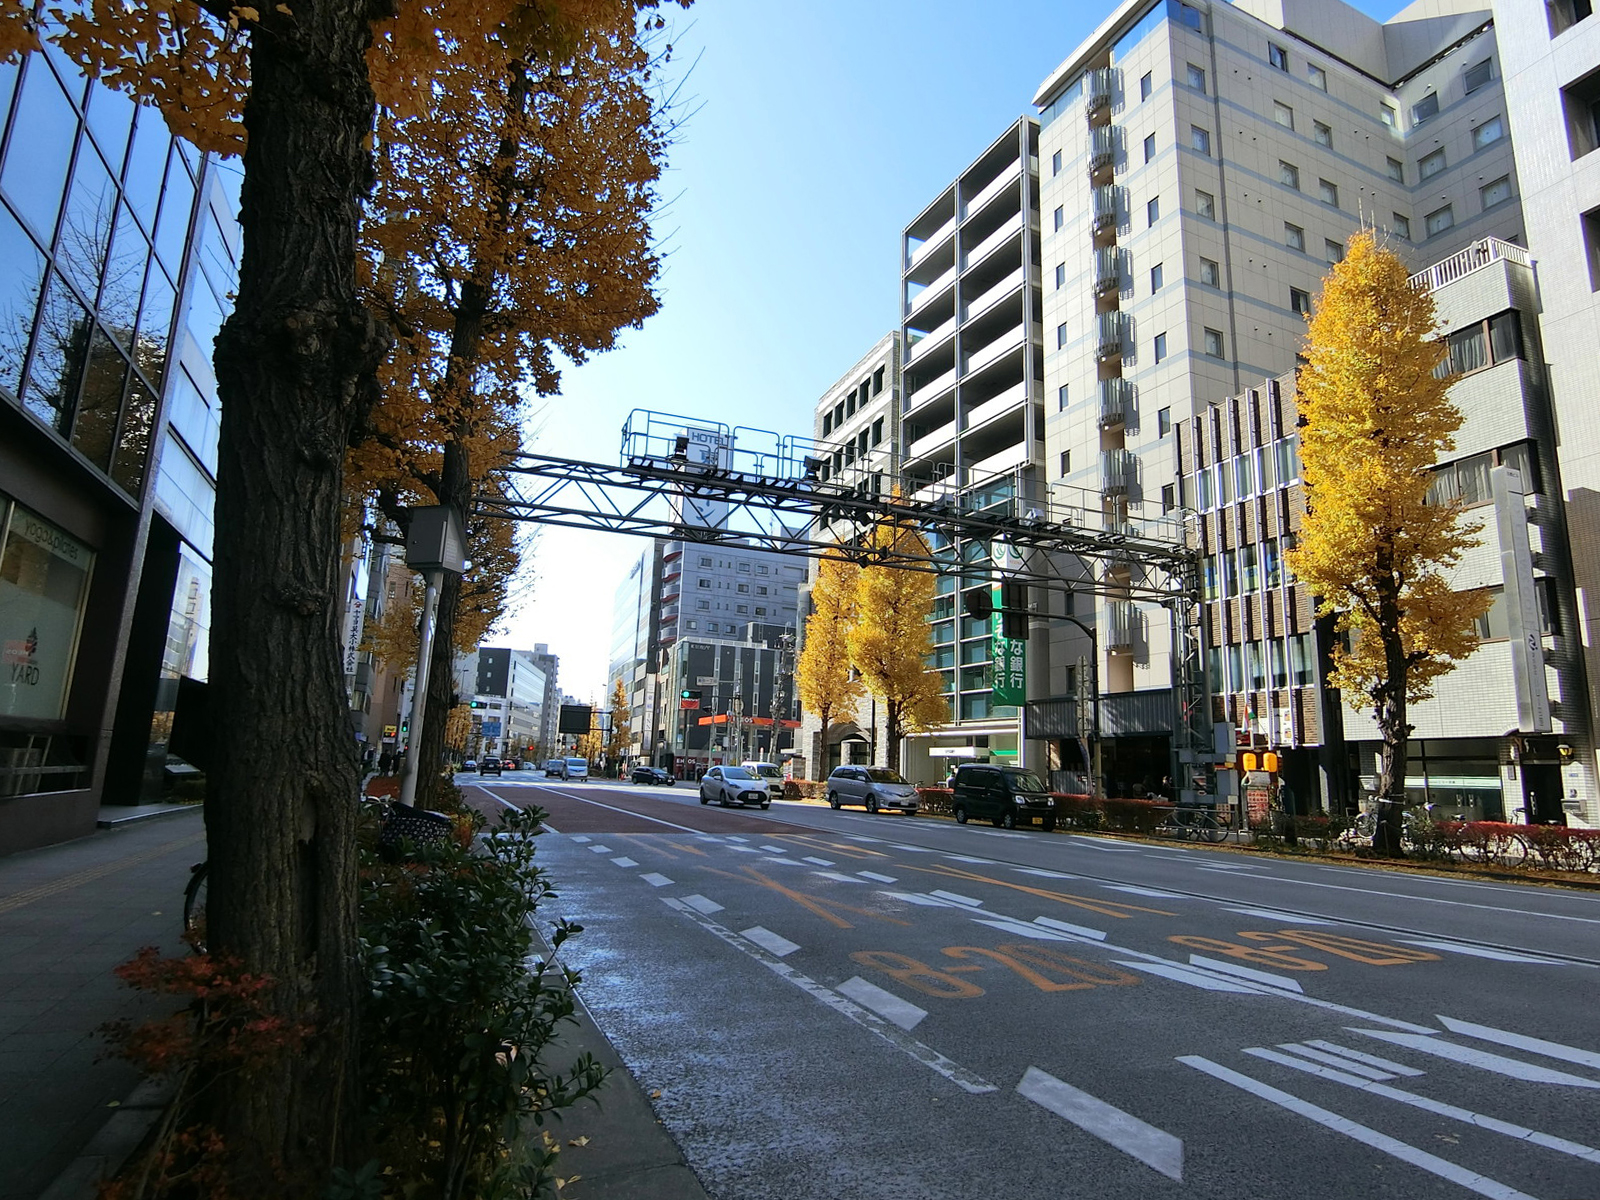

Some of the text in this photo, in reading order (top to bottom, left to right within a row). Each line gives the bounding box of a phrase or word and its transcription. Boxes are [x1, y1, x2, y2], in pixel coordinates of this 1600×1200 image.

[692, 431, 727, 446] HOTEL
[11, 662, 40, 686] YARD
[1010, 639, 1023, 689] な銀行
[849, 943, 1145, 999] 8-20
[1166, 929, 1444, 971] 8-20
